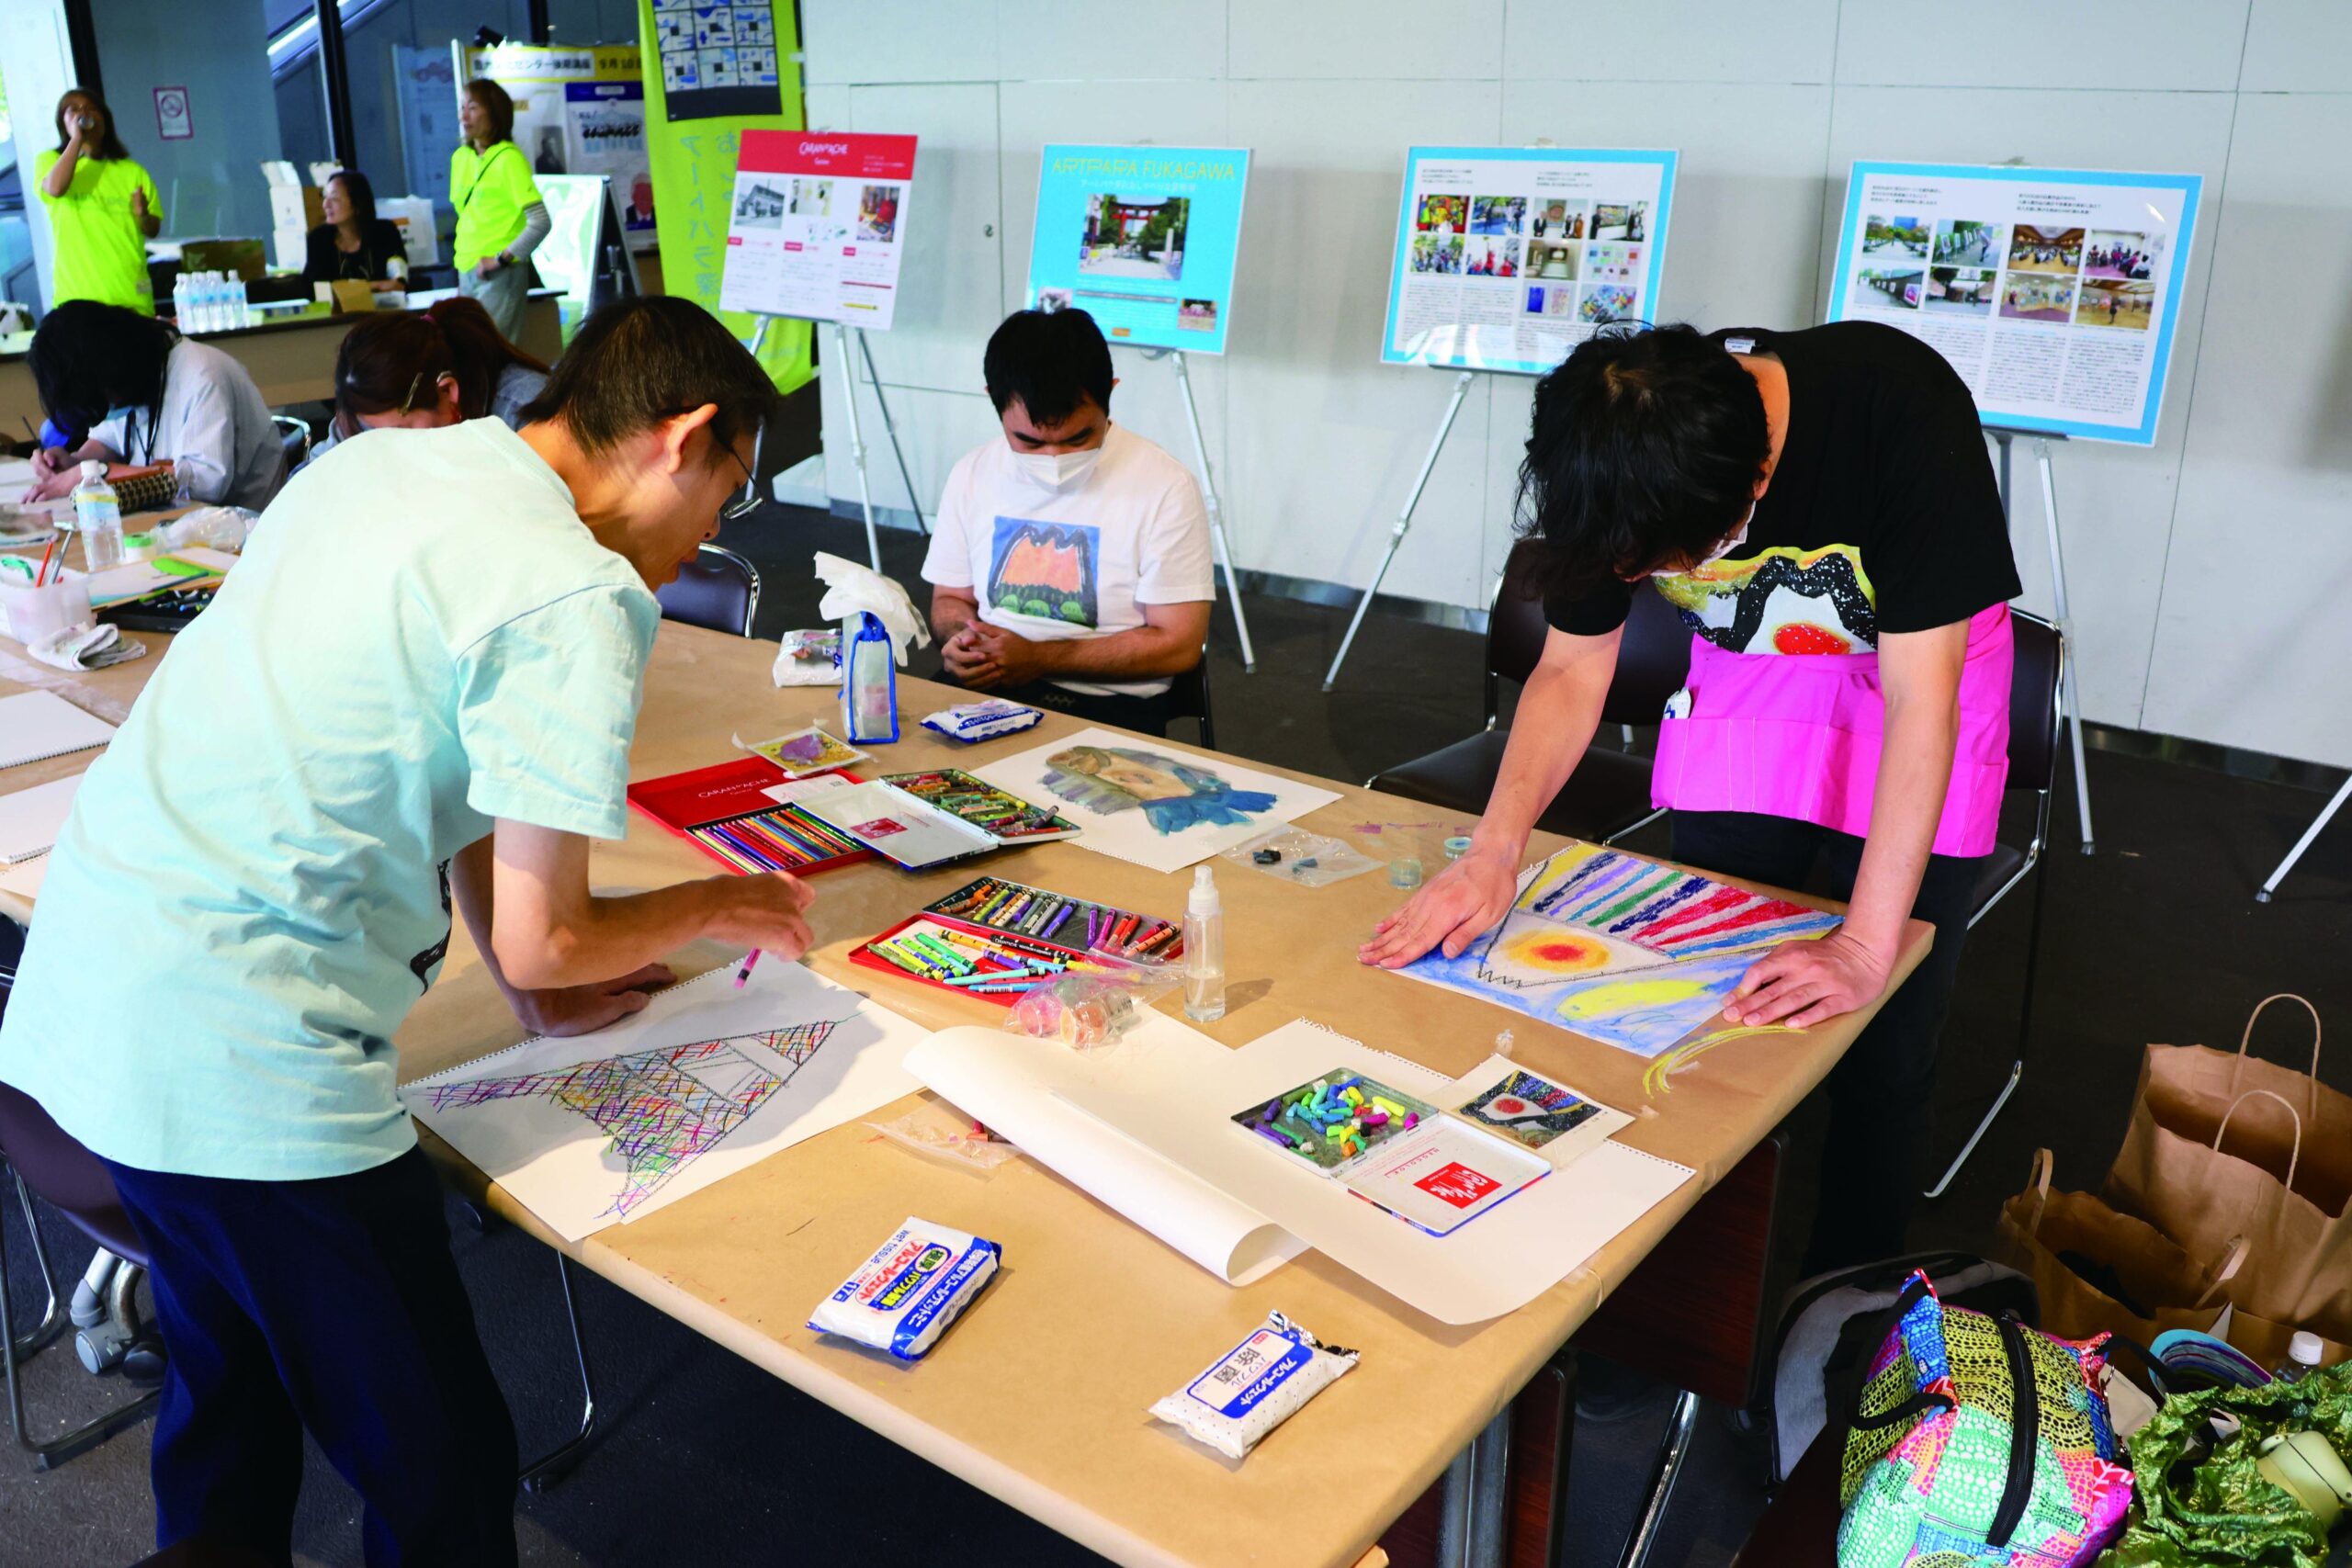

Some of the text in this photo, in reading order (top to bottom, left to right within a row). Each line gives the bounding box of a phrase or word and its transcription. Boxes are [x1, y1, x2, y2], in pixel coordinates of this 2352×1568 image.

[1052, 157, 1236, 181] ARTPARA FUKAGAWA
[870, 1229, 910, 1265] wet tissue
[859, 1241, 923, 1301] アルコールウェット
[1213, 1348, 1261, 1384] 除菌
[1239, 1358, 1297, 1406] アルコールウェット
